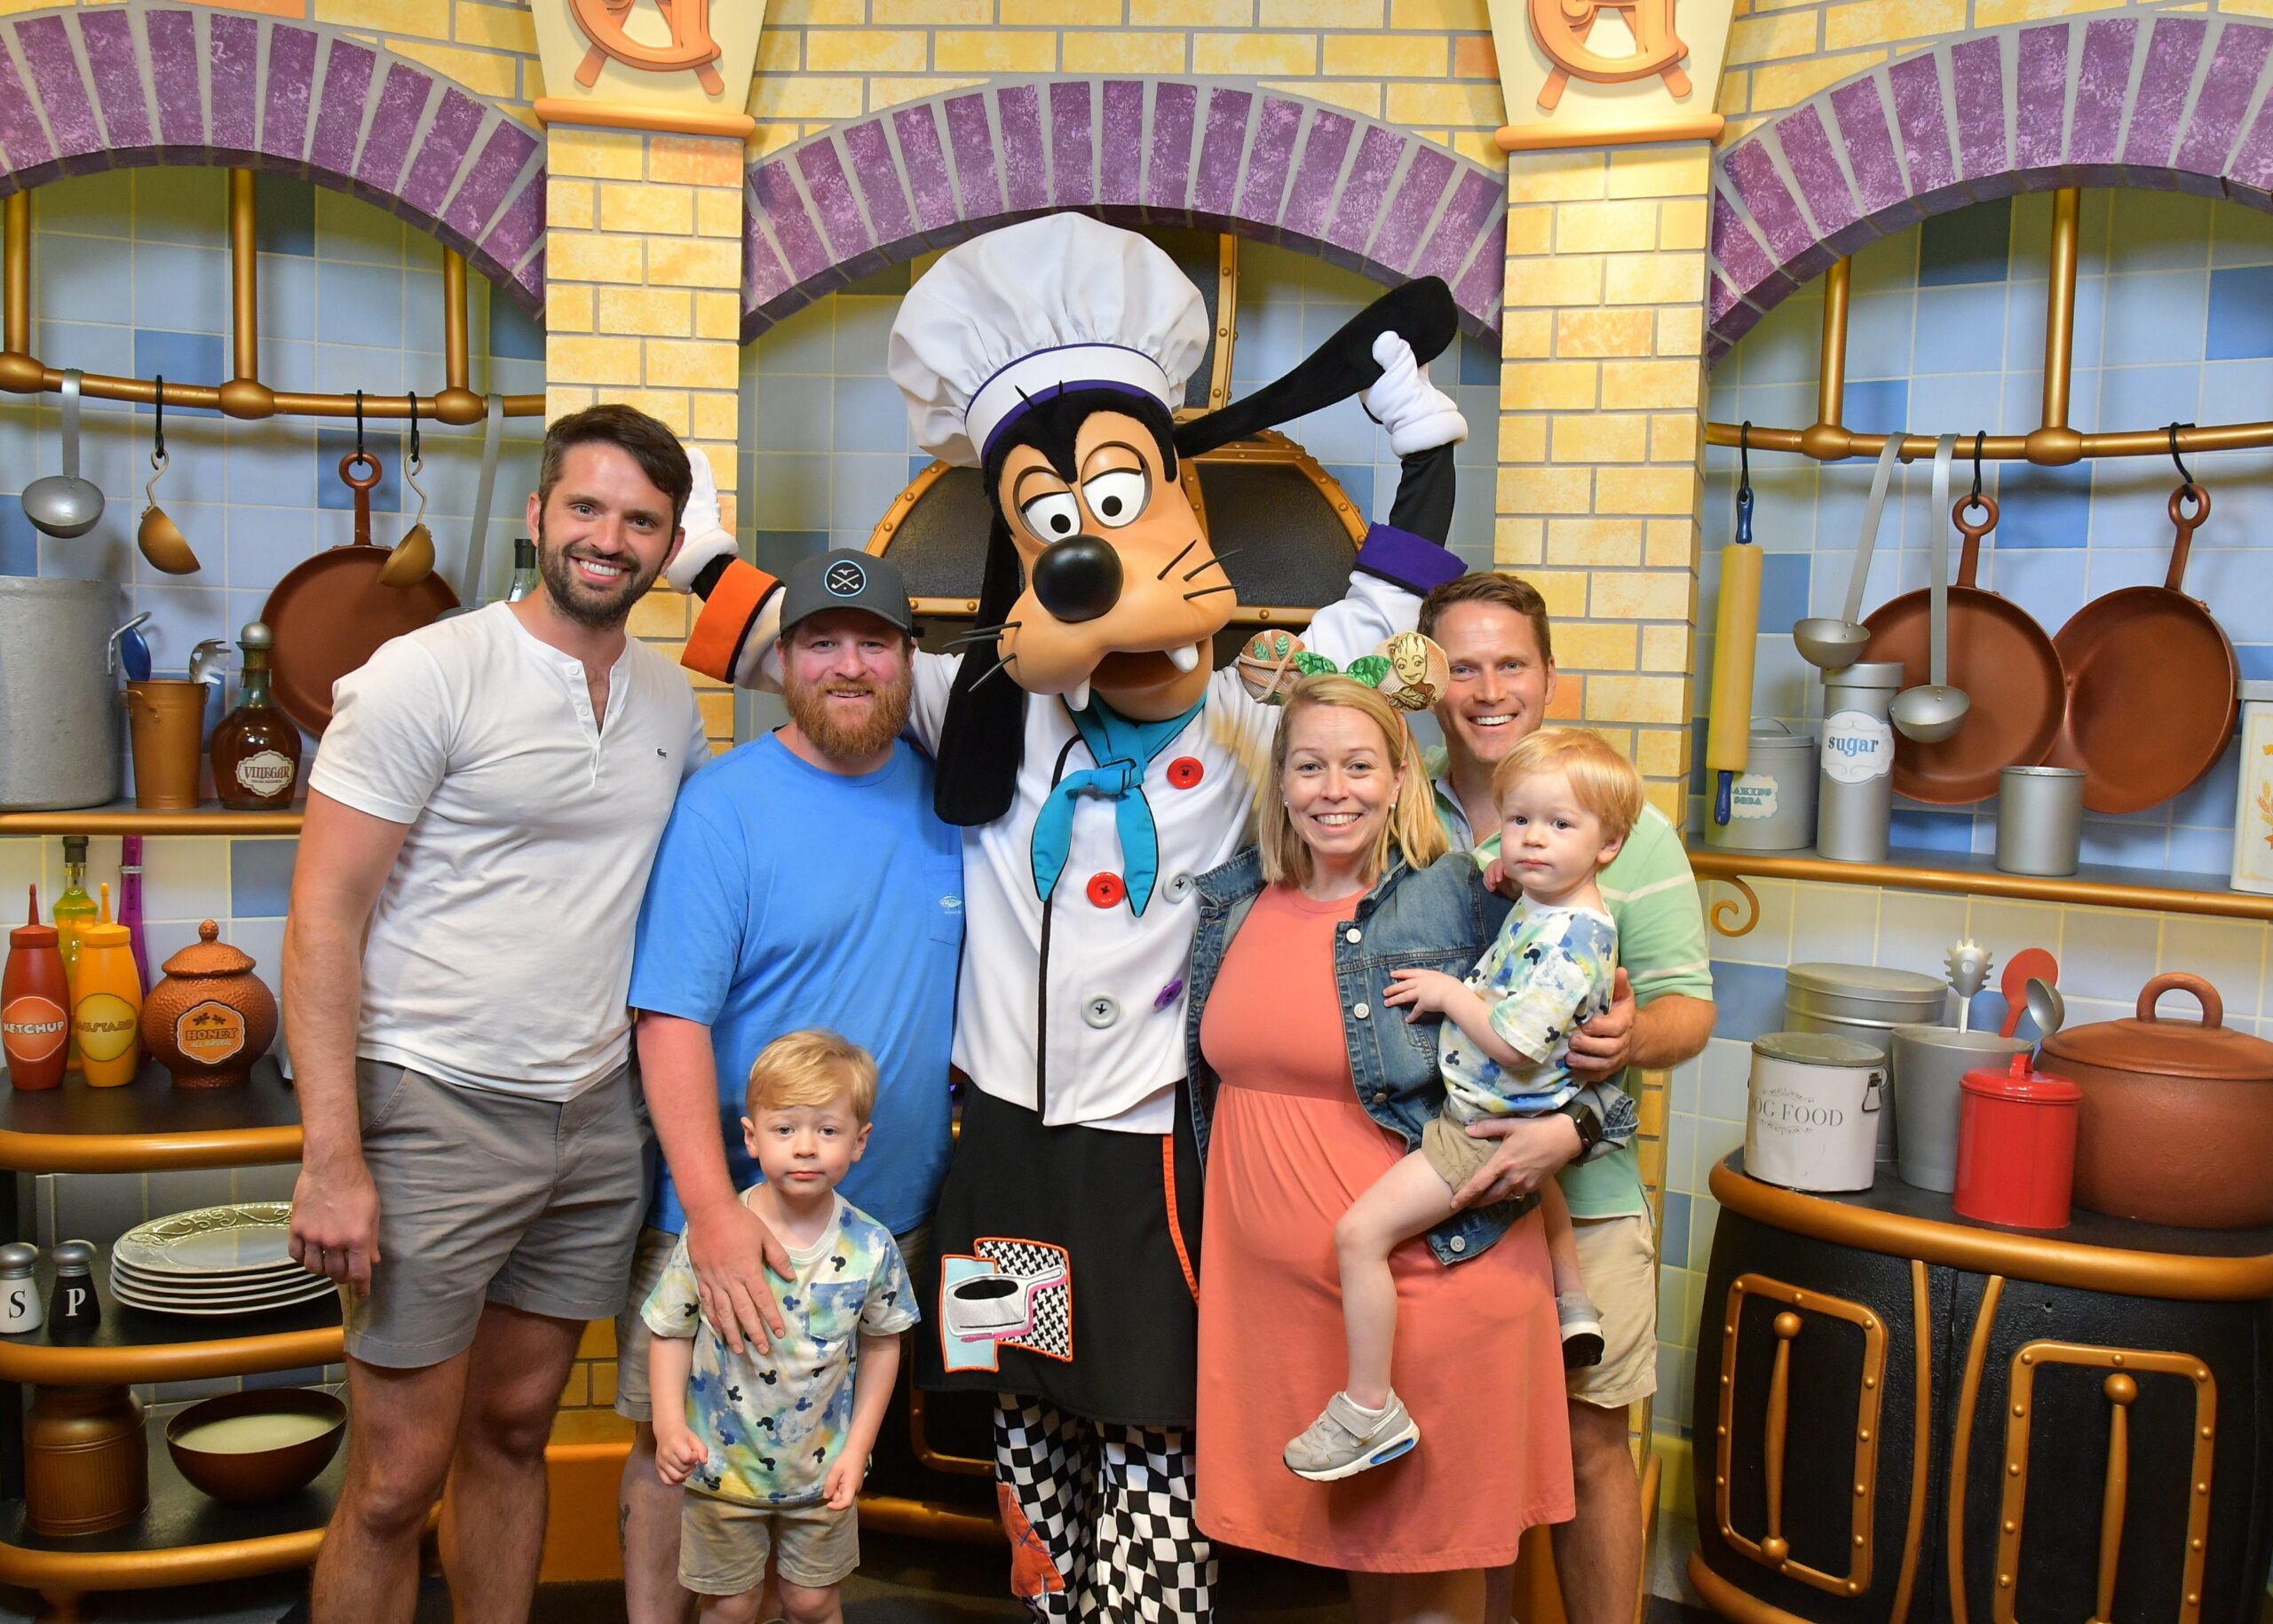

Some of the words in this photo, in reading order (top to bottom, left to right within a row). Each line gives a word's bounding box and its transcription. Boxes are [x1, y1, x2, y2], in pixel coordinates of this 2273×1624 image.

[1827, 736, 1879, 757] sugar
[1734, 796, 1762, 805] SODA
[4, 1019, 65, 1034] KETCHUP
[185, 1027, 238, 1041] HONEY
[1782, 1103, 1843, 1127] FOOD
[8, 1288, 26, 1319] S
[65, 1287, 86, 1317] P
